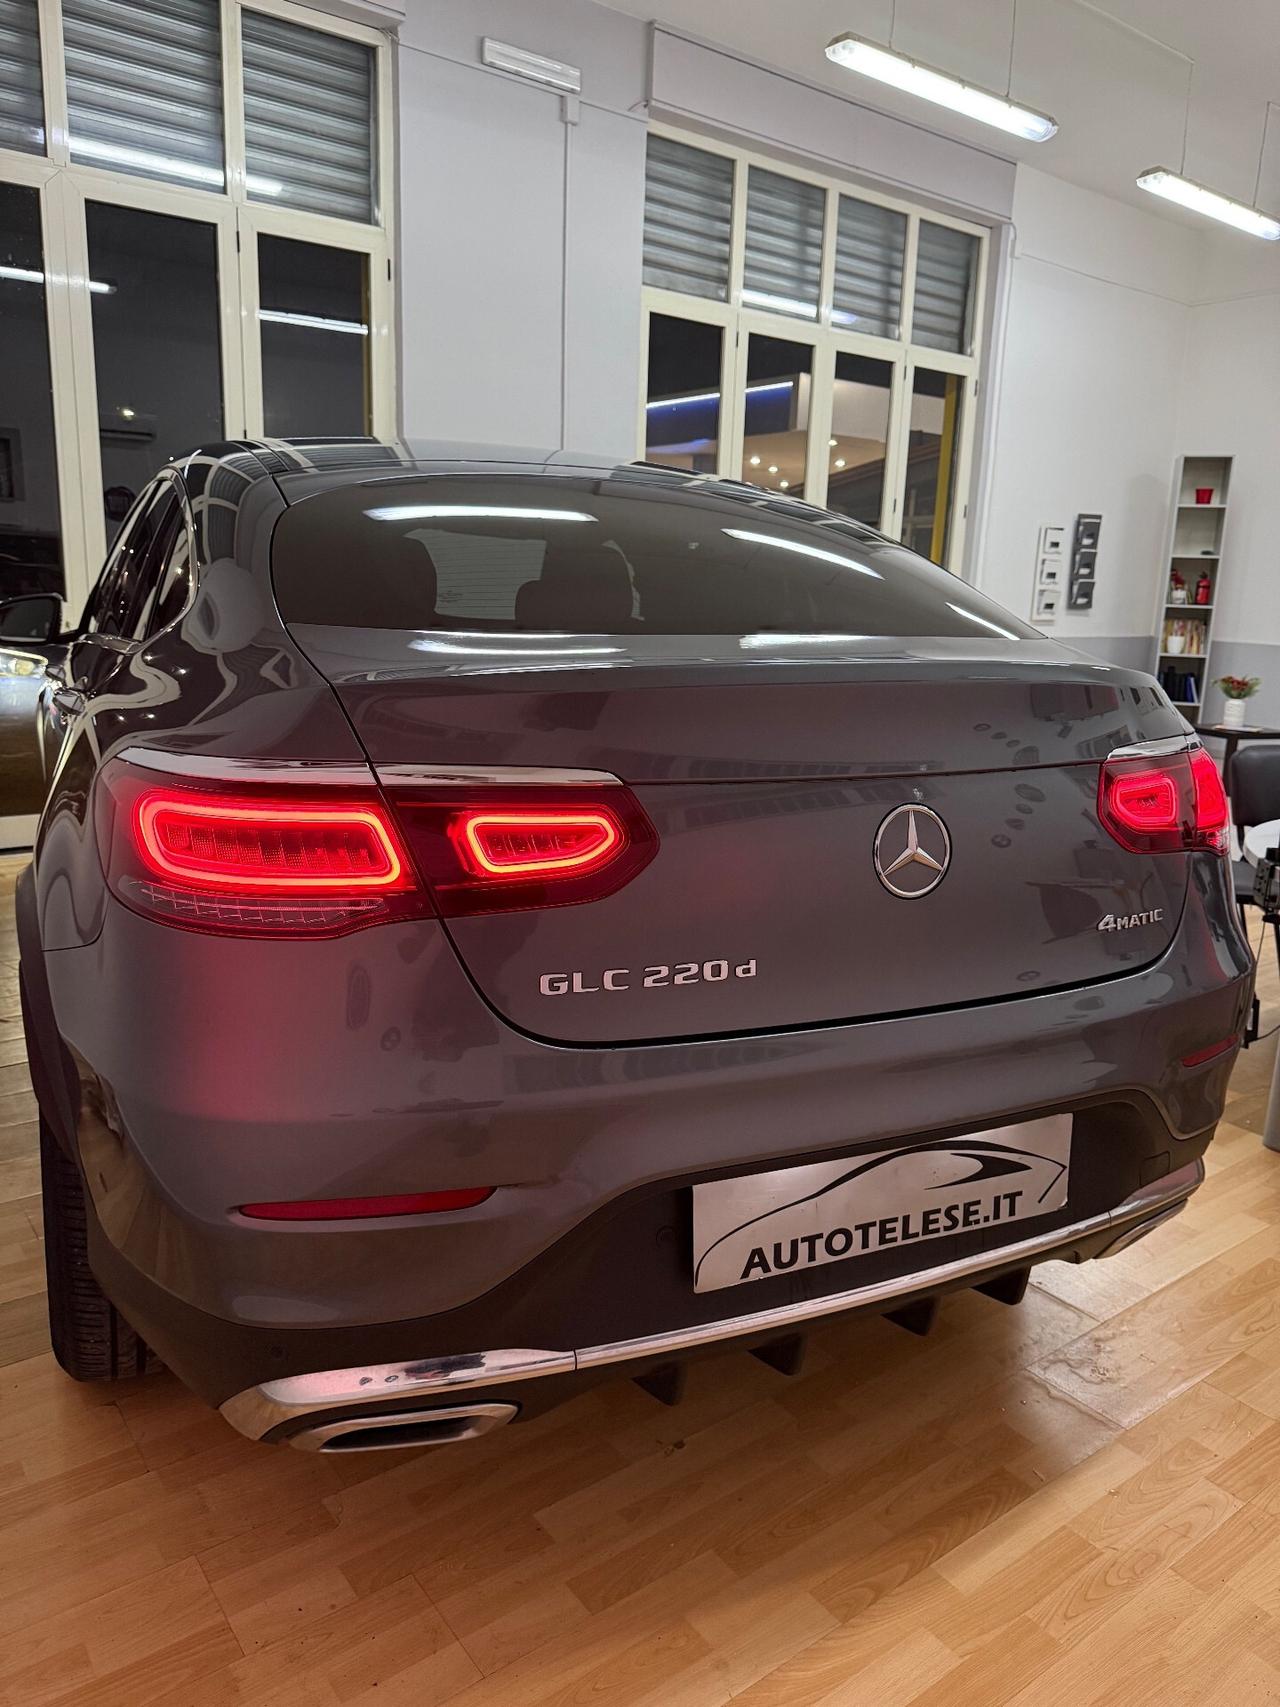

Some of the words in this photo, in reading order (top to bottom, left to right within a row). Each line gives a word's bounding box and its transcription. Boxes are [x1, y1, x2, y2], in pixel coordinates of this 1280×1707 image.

[1098, 908, 1163, 932] 4MATIC
[540, 969, 631, 996] GLC
[740, 1190, 1023, 1280] AUTOTELESE.IT
